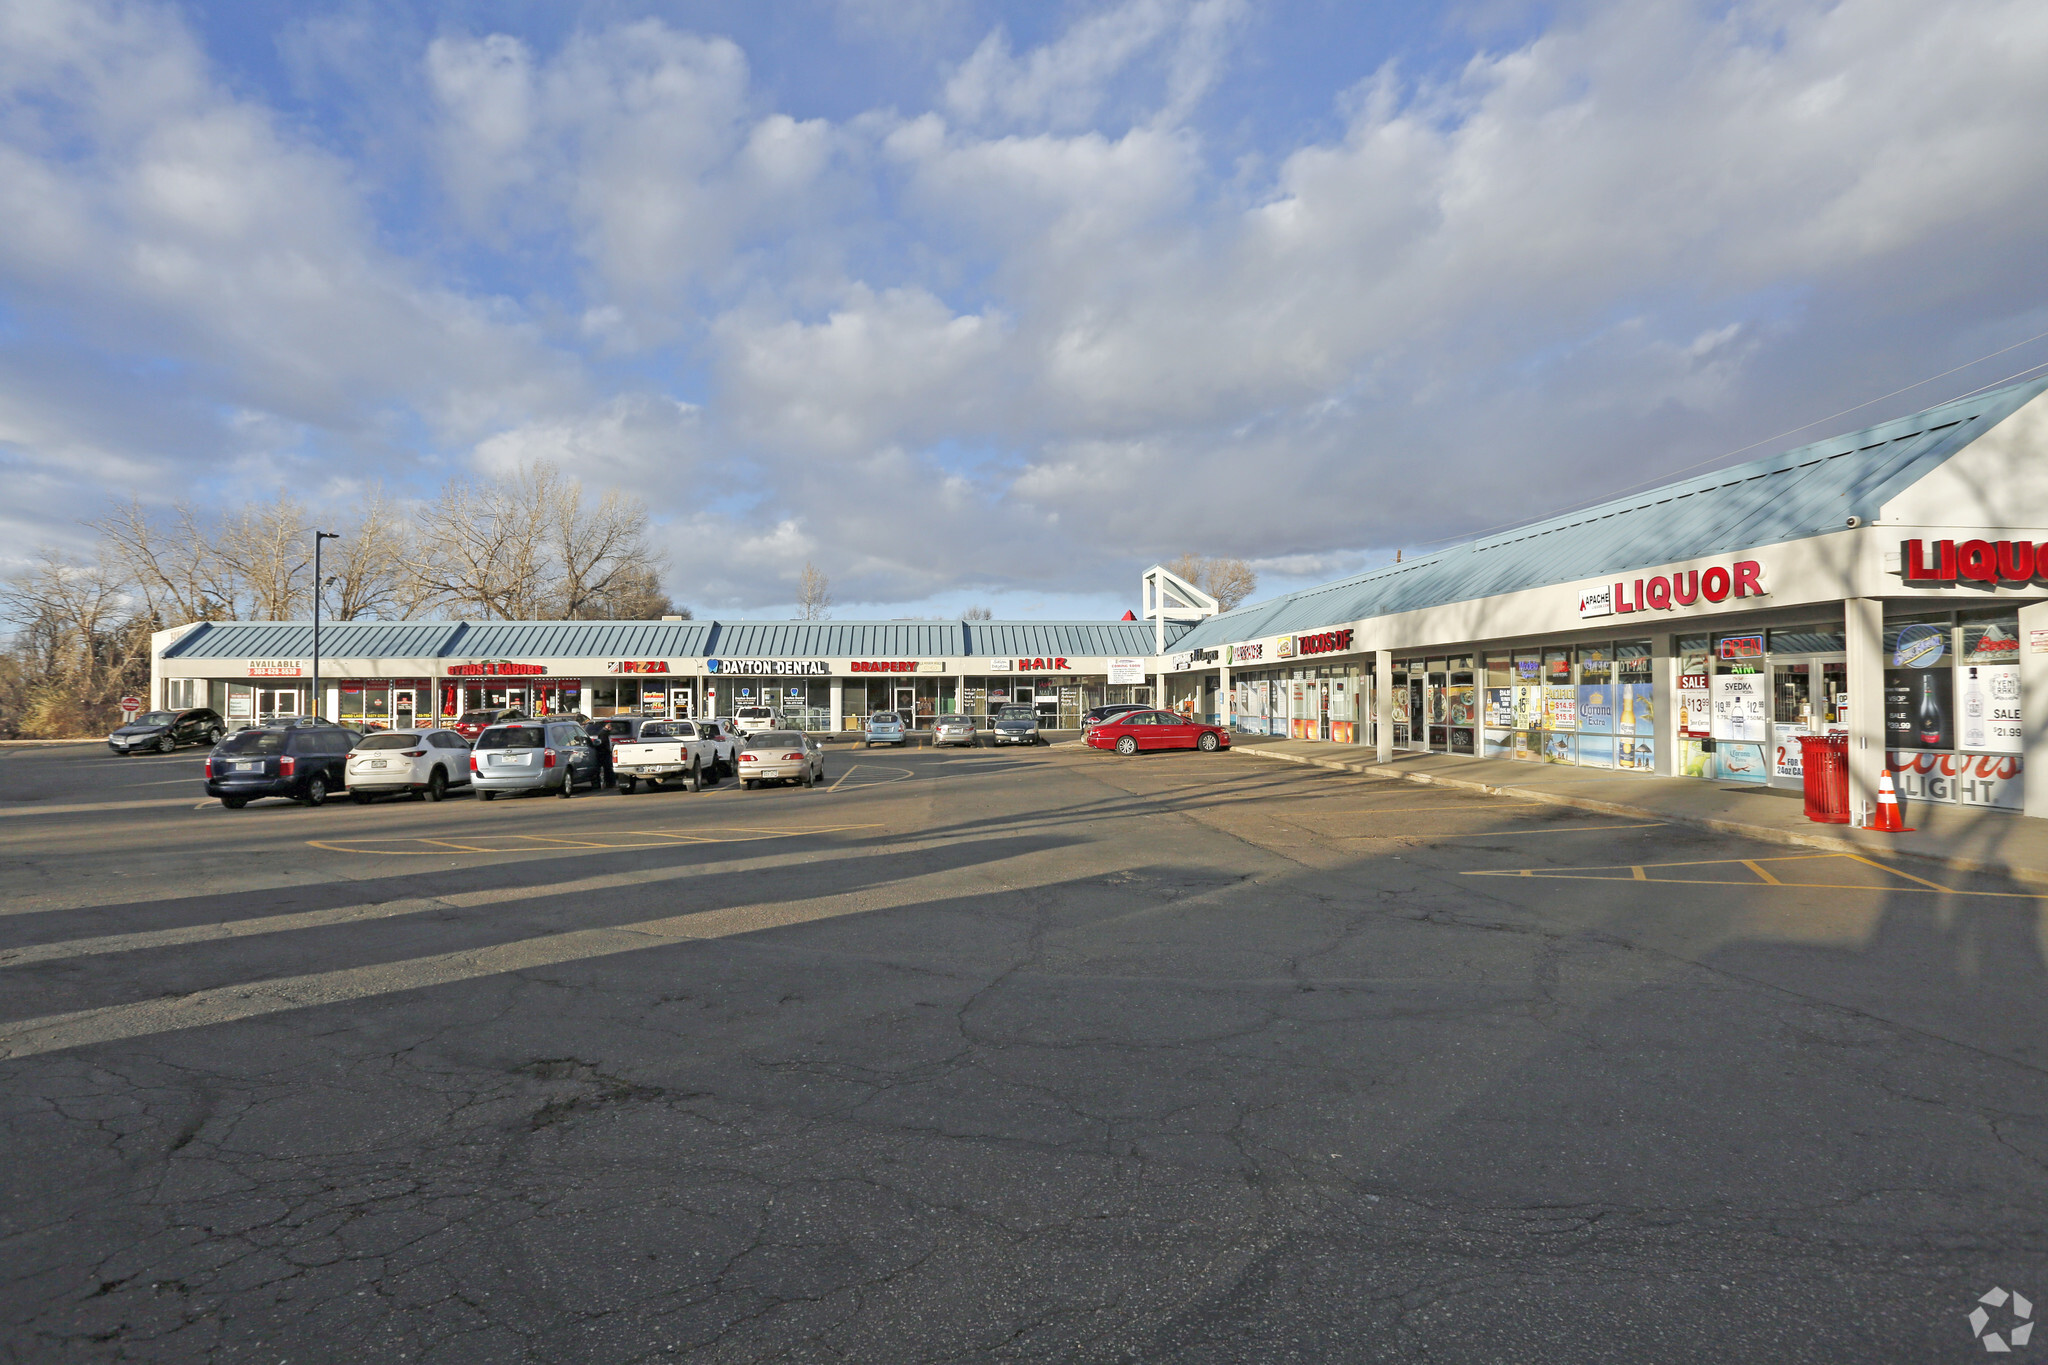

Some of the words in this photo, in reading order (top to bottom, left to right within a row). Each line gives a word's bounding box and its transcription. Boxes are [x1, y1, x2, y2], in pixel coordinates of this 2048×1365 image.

[1615, 561, 1765, 612] LIQUOR
[1586, 593, 1609, 605] APACHE
[1298, 632, 1333, 655] TACOS
[1335, 629, 1351, 651] DF
[1722, 638, 1761, 658] OPEN
[447, 664, 484, 675] GYROS
[497, 663, 543, 675] KABOBS
[623, 661, 668, 673] PIZZA
[723, 660, 772, 674] DAYTON
[777, 660, 825, 674] DENTAL
[850, 661, 917, 672] DRAPERY
[1018, 657, 1071, 671] HAIR
[1682, 676, 1706, 689] SALE
[1725, 683, 1753, 691] SVEDKA
[1556, 713, 1576, 721] $15.99
[1581, 704, 1611, 718] Corona
[1994, 709, 2021, 720] SALE
[1589, 716, 1605, 726] Extra
[1994, 727, 2022, 737] $21.99
[1777, 746, 1786, 765] 2
[1787, 758, 1798, 766] FOR
[1777, 766, 1792, 775] 24oz
[1792, 767, 1804, 776] CA
[1906, 775, 1995, 803] LIGHT
